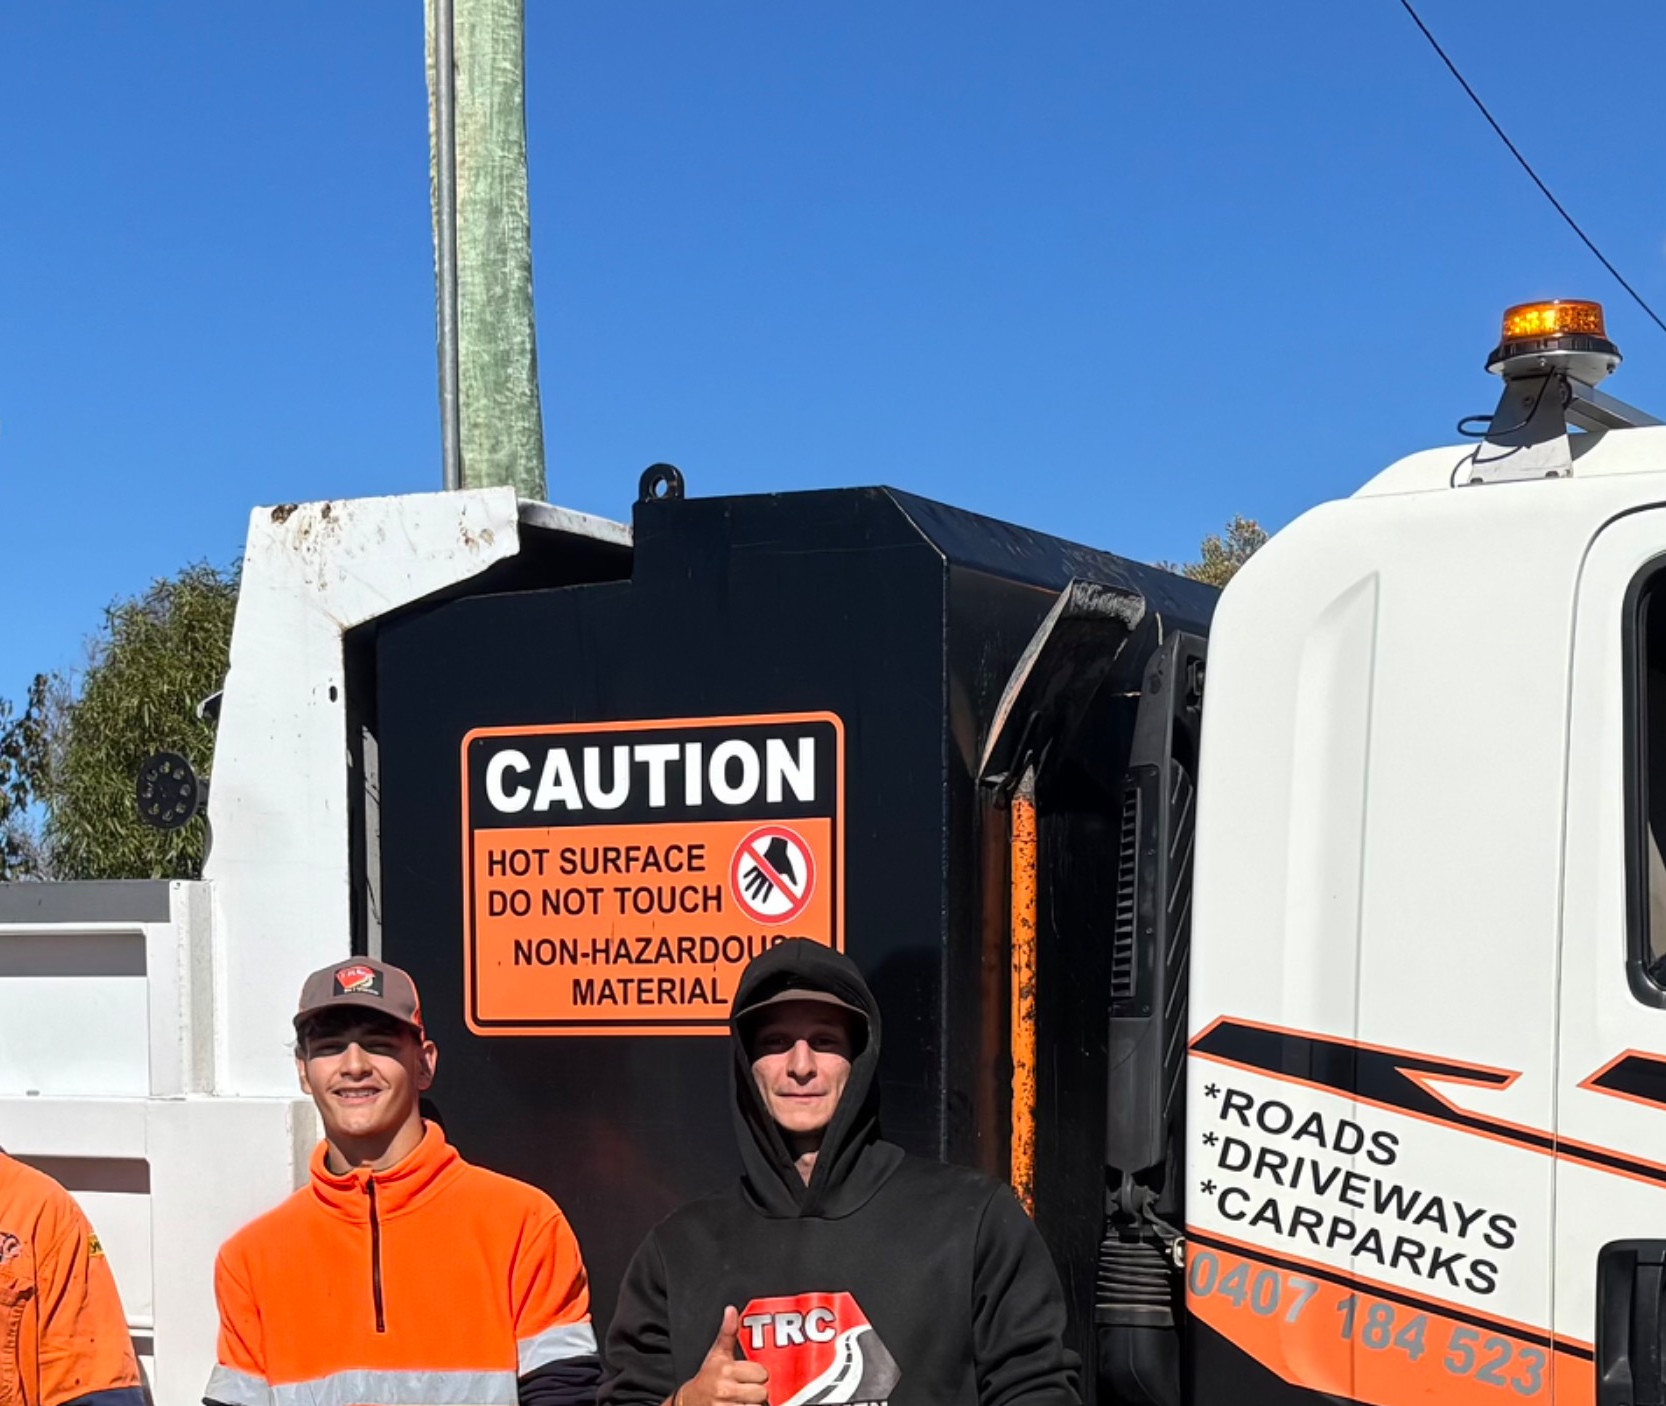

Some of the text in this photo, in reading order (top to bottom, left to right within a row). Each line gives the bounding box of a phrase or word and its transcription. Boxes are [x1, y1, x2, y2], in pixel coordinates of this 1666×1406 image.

[485, 736, 815, 813] CAUTION
[488, 843, 706, 877] HOT SURFACE
[489, 885, 722, 917] DO NOT TOUCH
[572, 976, 729, 1006] MATERIAL
[743, 1307, 837, 1349] TRC
[1189, 1251, 1545, 1395] 0407 184 523
